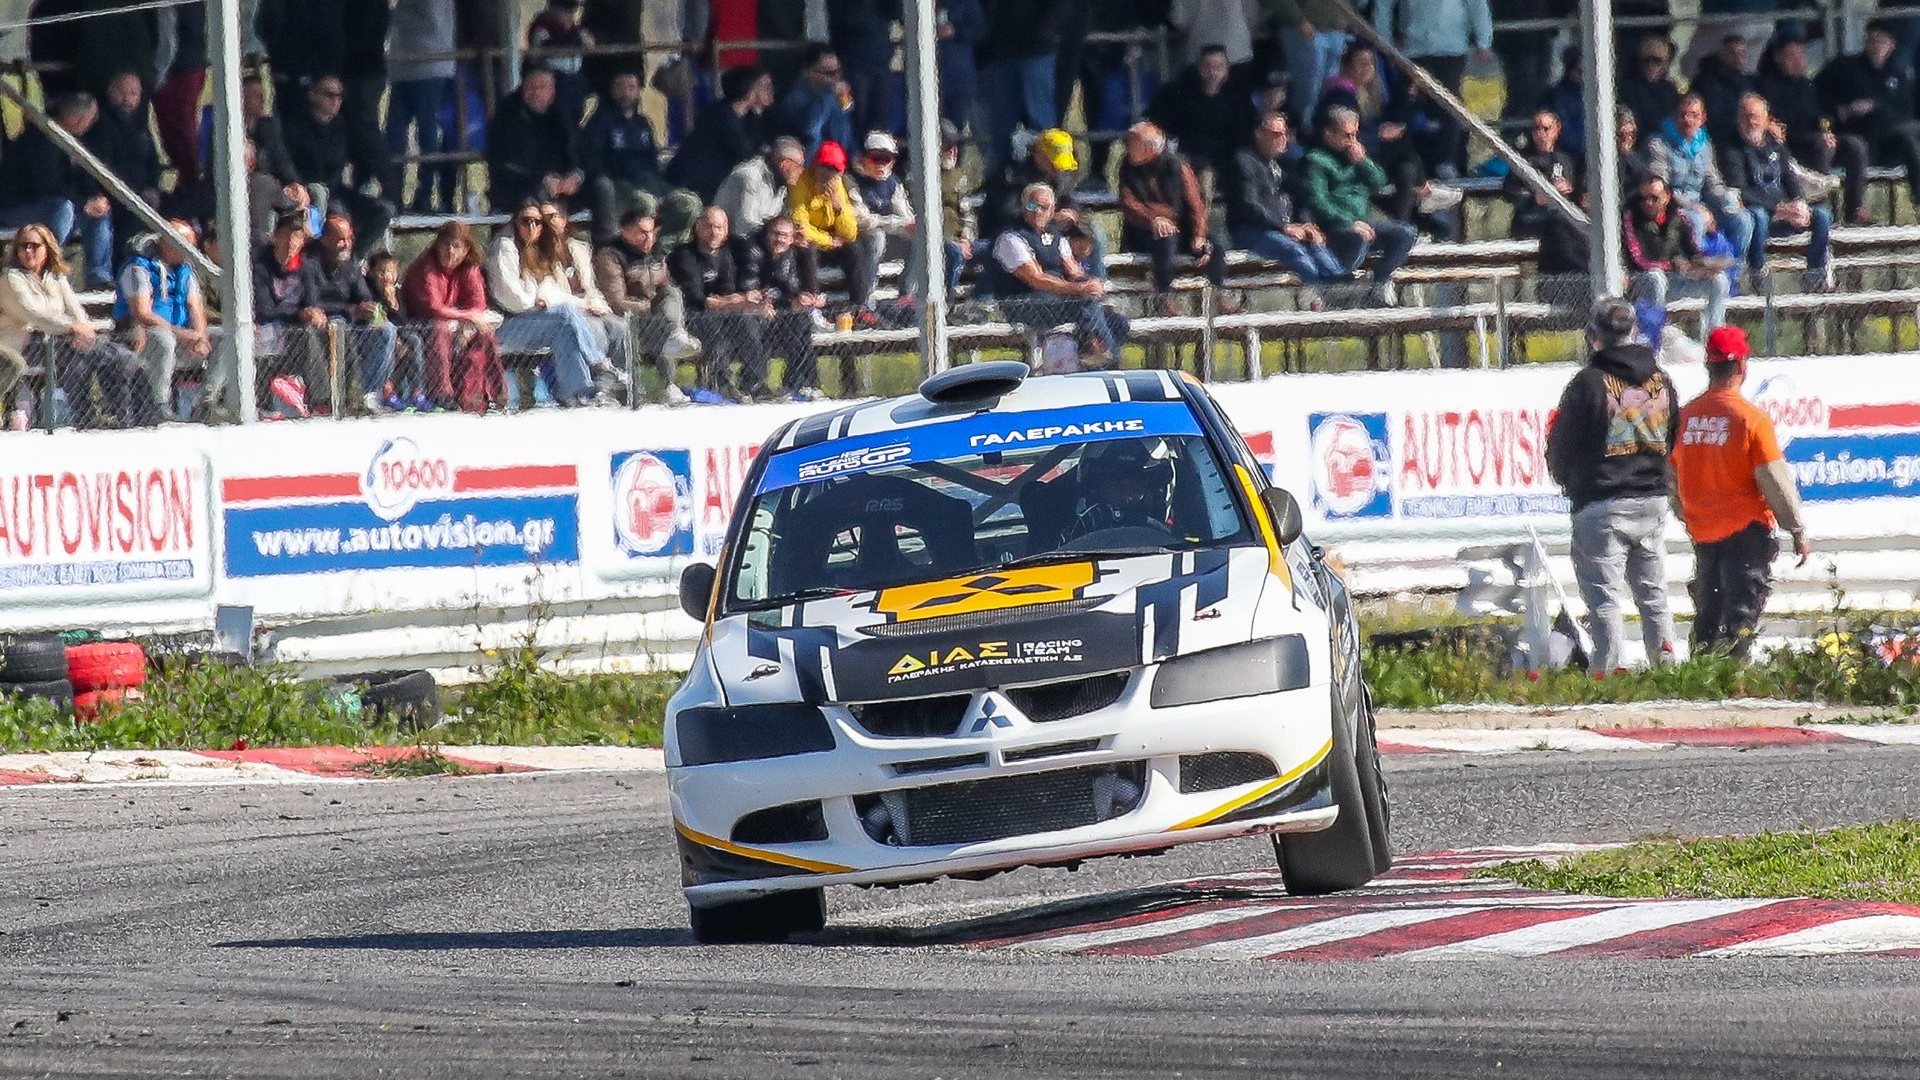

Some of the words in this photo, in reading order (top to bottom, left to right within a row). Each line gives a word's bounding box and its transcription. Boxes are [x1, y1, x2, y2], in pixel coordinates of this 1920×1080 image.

[970, 419, 1144, 447] ΓΑΛΕΡΑΚΗΣ
[1687, 416, 1728, 431] RACE
[381, 459, 448, 491] 10600
[252, 513, 555, 557] www.autovision.gr
[1023, 639, 1083, 650] RACING
[1023, 646, 1070, 655] TEAM
[888, 641, 1008, 674] ΔΙΑΣ
[887, 665, 955, 684] ΓΑΛΕΡΑΚΗΣ
